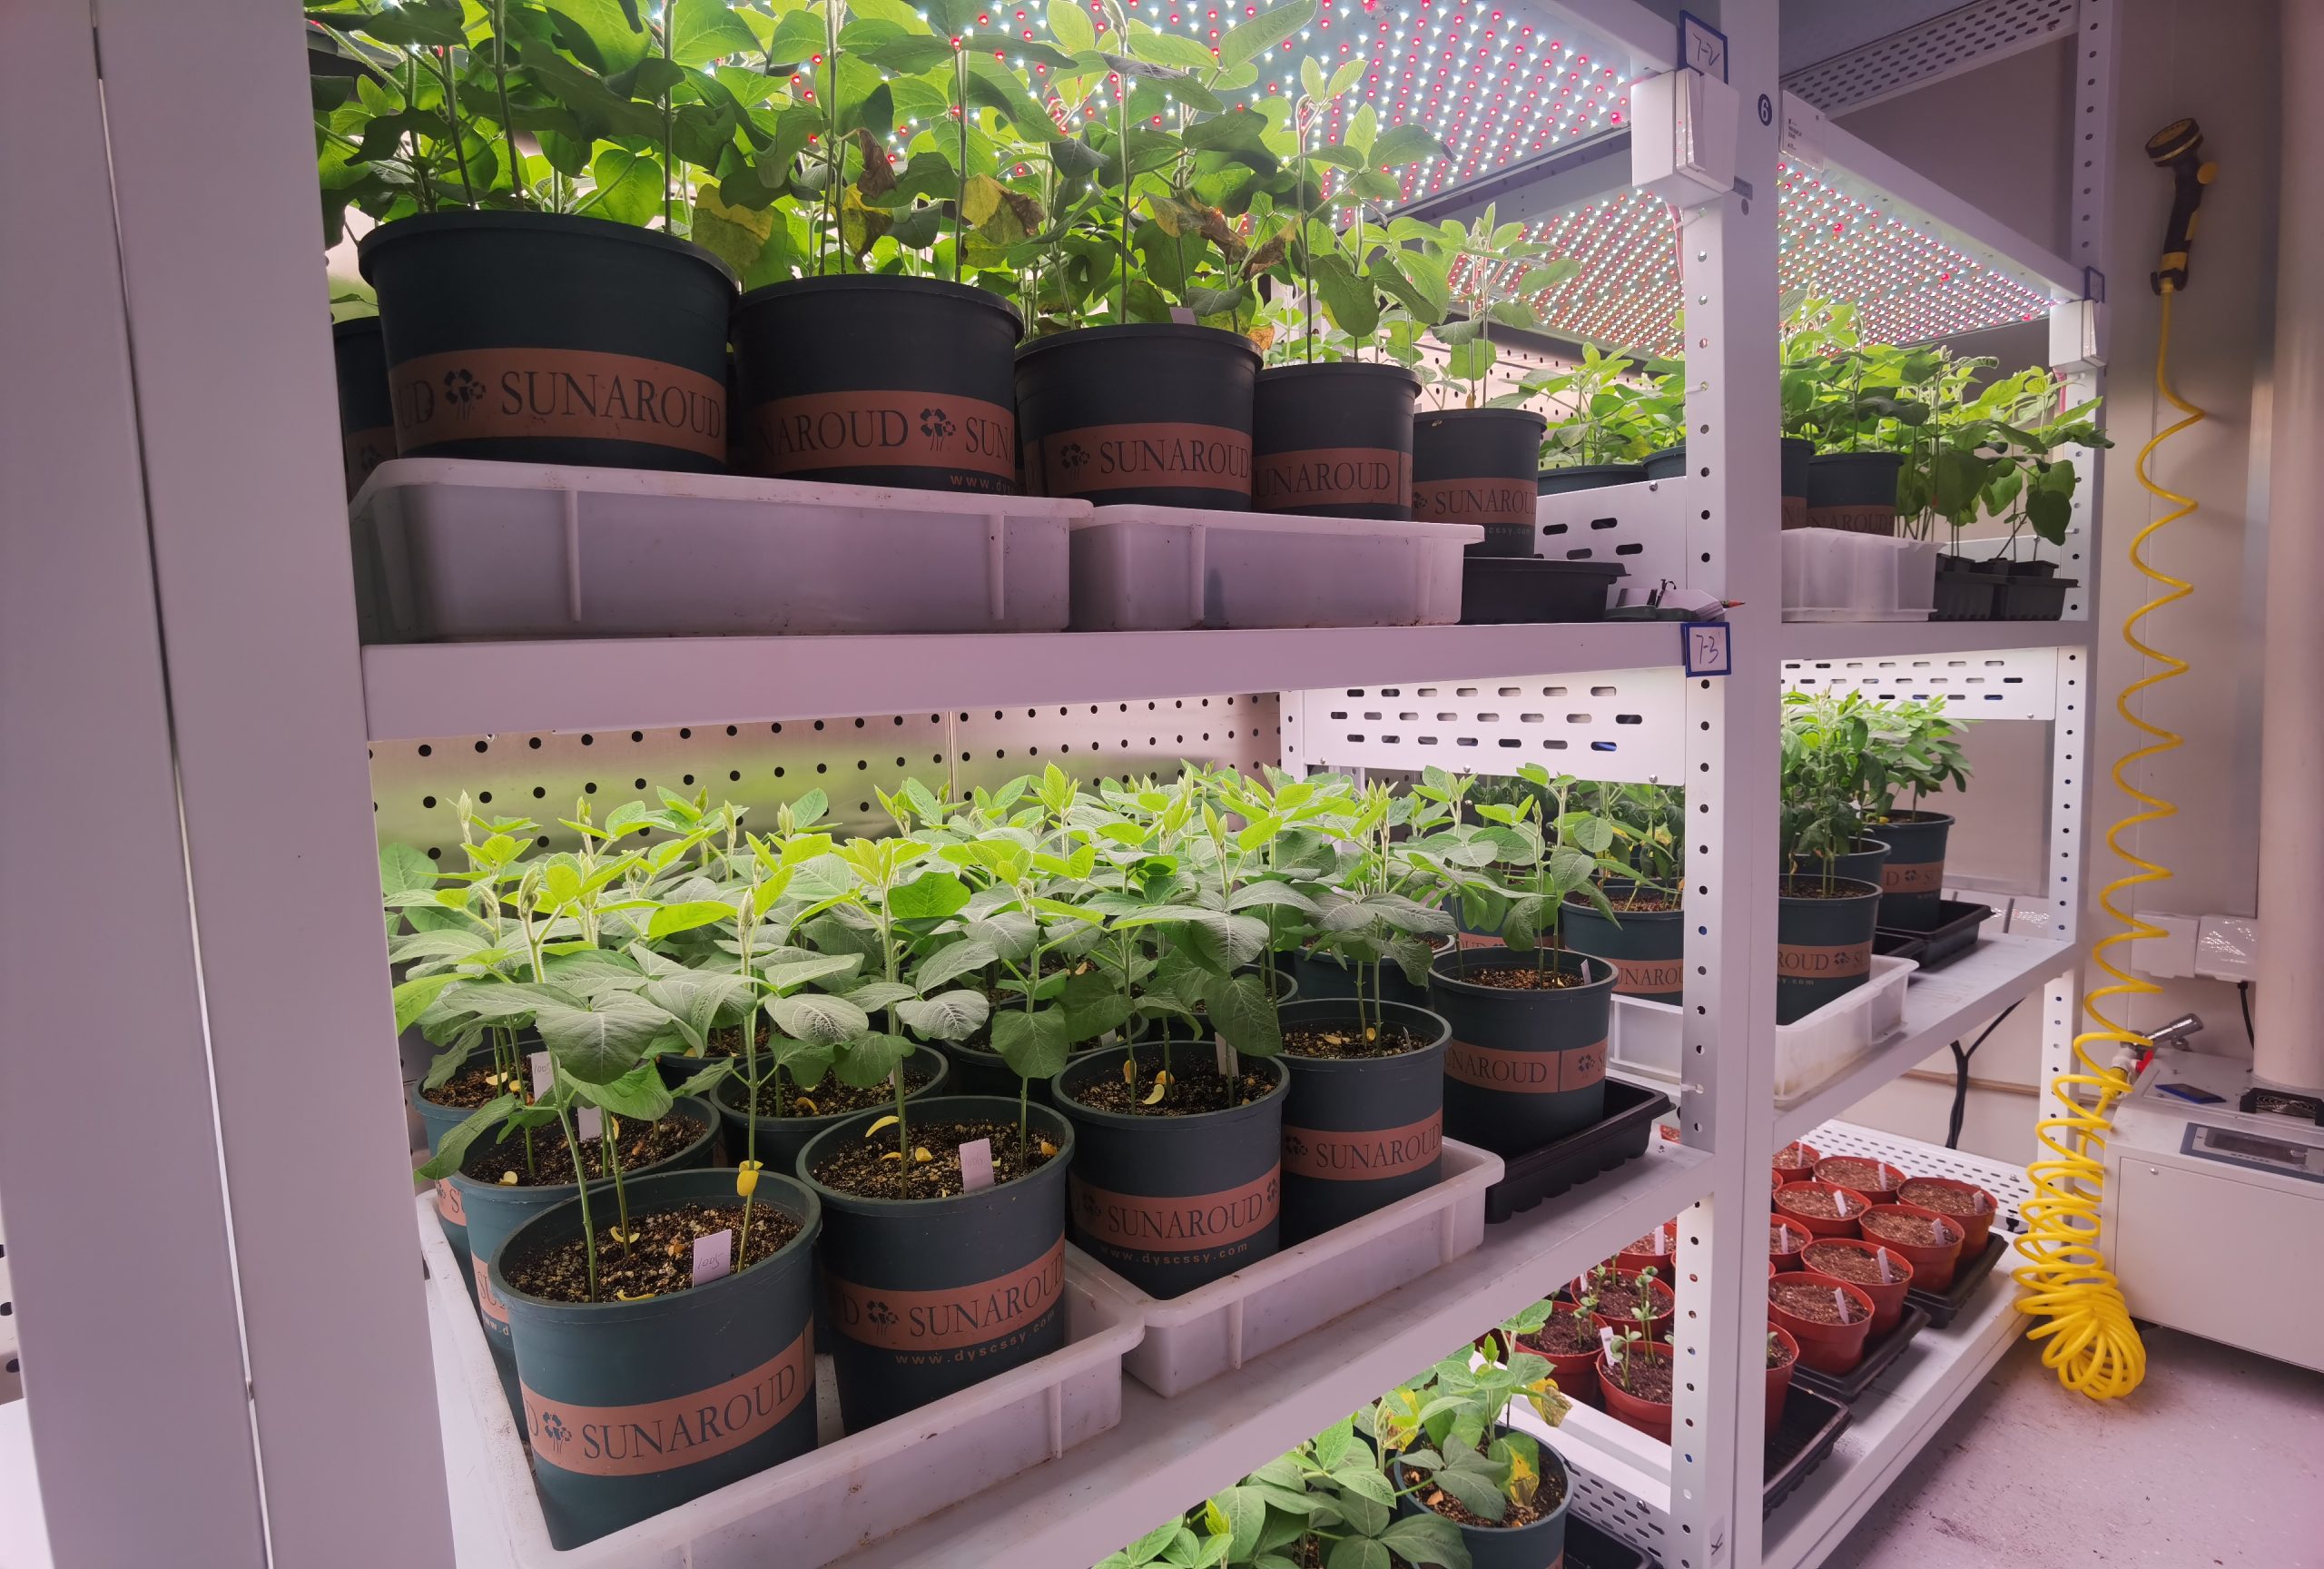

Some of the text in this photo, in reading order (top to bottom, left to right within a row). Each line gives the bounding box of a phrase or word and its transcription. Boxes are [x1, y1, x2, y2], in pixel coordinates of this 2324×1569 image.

[1760, 99, 1769, 123] 6
[501, 370, 721, 439] SUNAROUD
[1100, 438, 1250, 479] SUNAROUD
[1696, 635, 1719, 665] 7-3
[1316, 1123, 1441, 1169] SUNAROUD
[1108, 1193, 1263, 1238] SUNAROUD
[909, 1252, 1063, 1337] SUNAROUD
[582, 1365, 795, 1459] SUNAROUD
